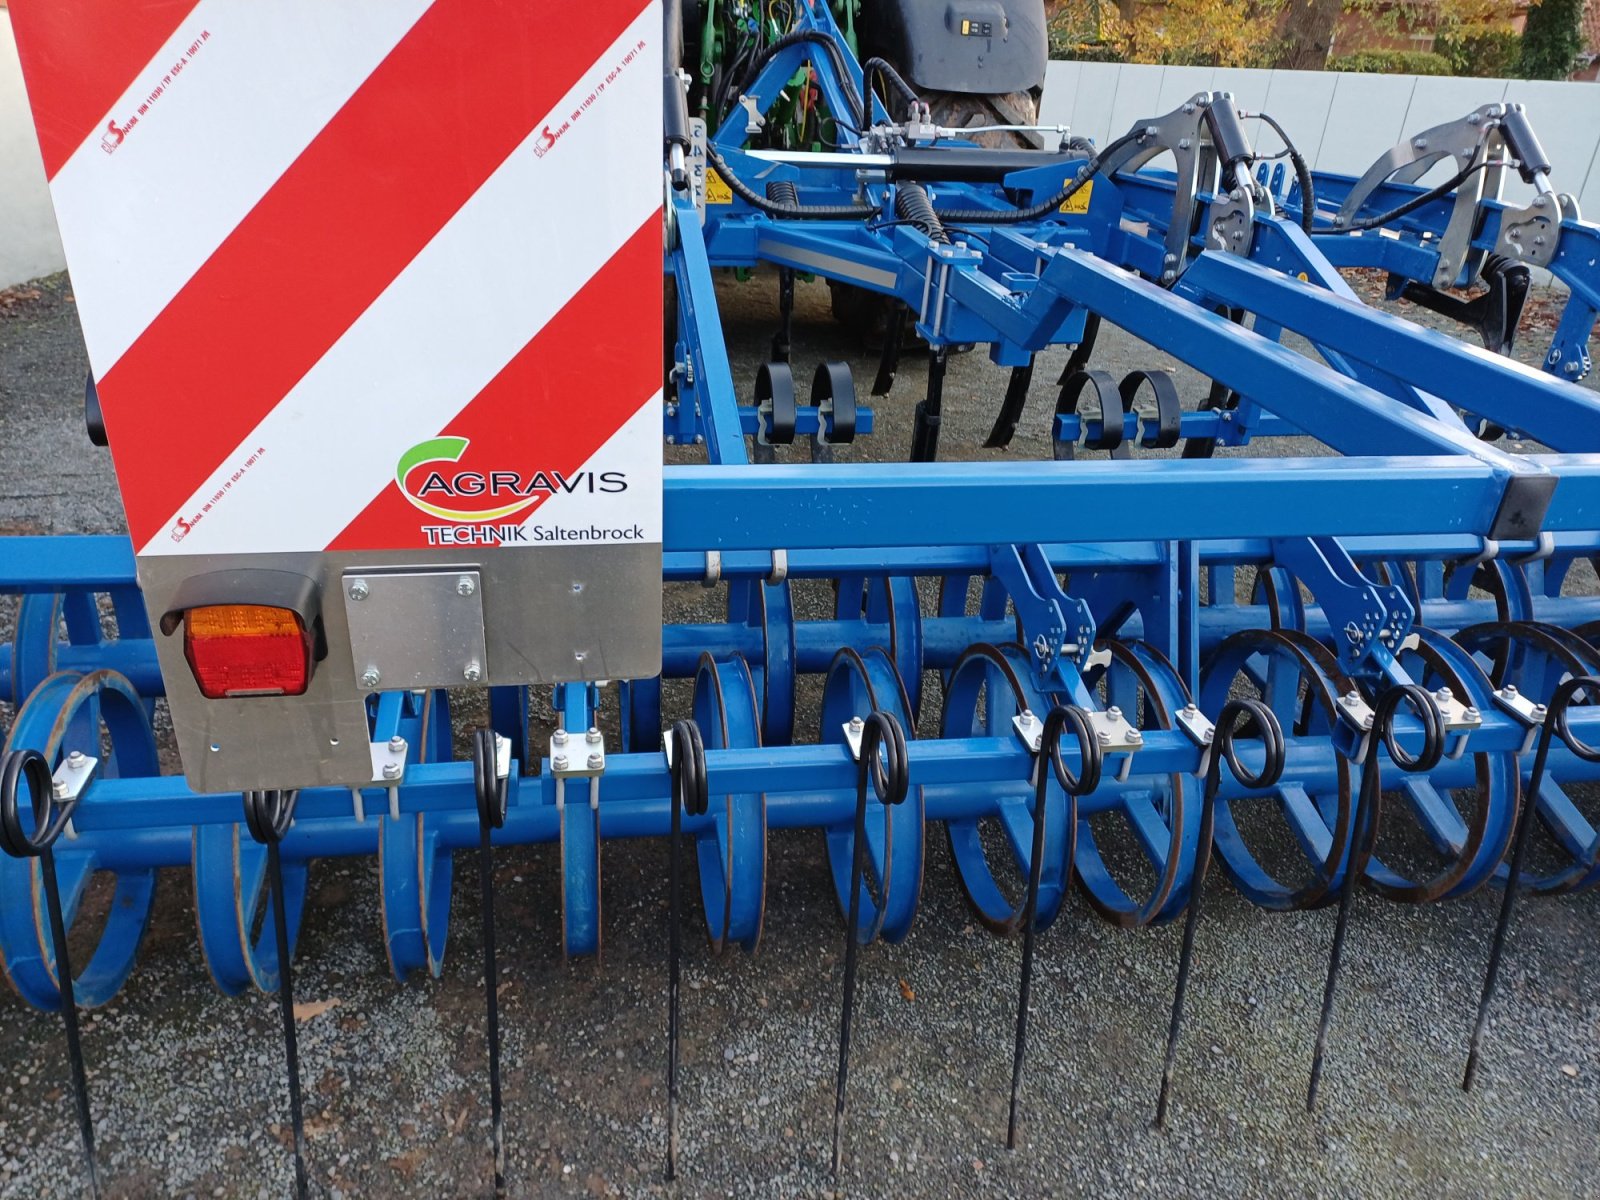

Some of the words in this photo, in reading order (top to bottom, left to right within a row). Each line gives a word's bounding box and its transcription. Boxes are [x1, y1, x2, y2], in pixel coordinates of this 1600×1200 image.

[138, 104, 148, 115] DIN
[147, 87, 163, 104] 11030
[571, 109, 582, 121] DIN
[419, 471, 628, 496] AGRAVIS
[422, 525, 528, 544] TECHNIK
[534, 523, 644, 541] Saltenbrock
